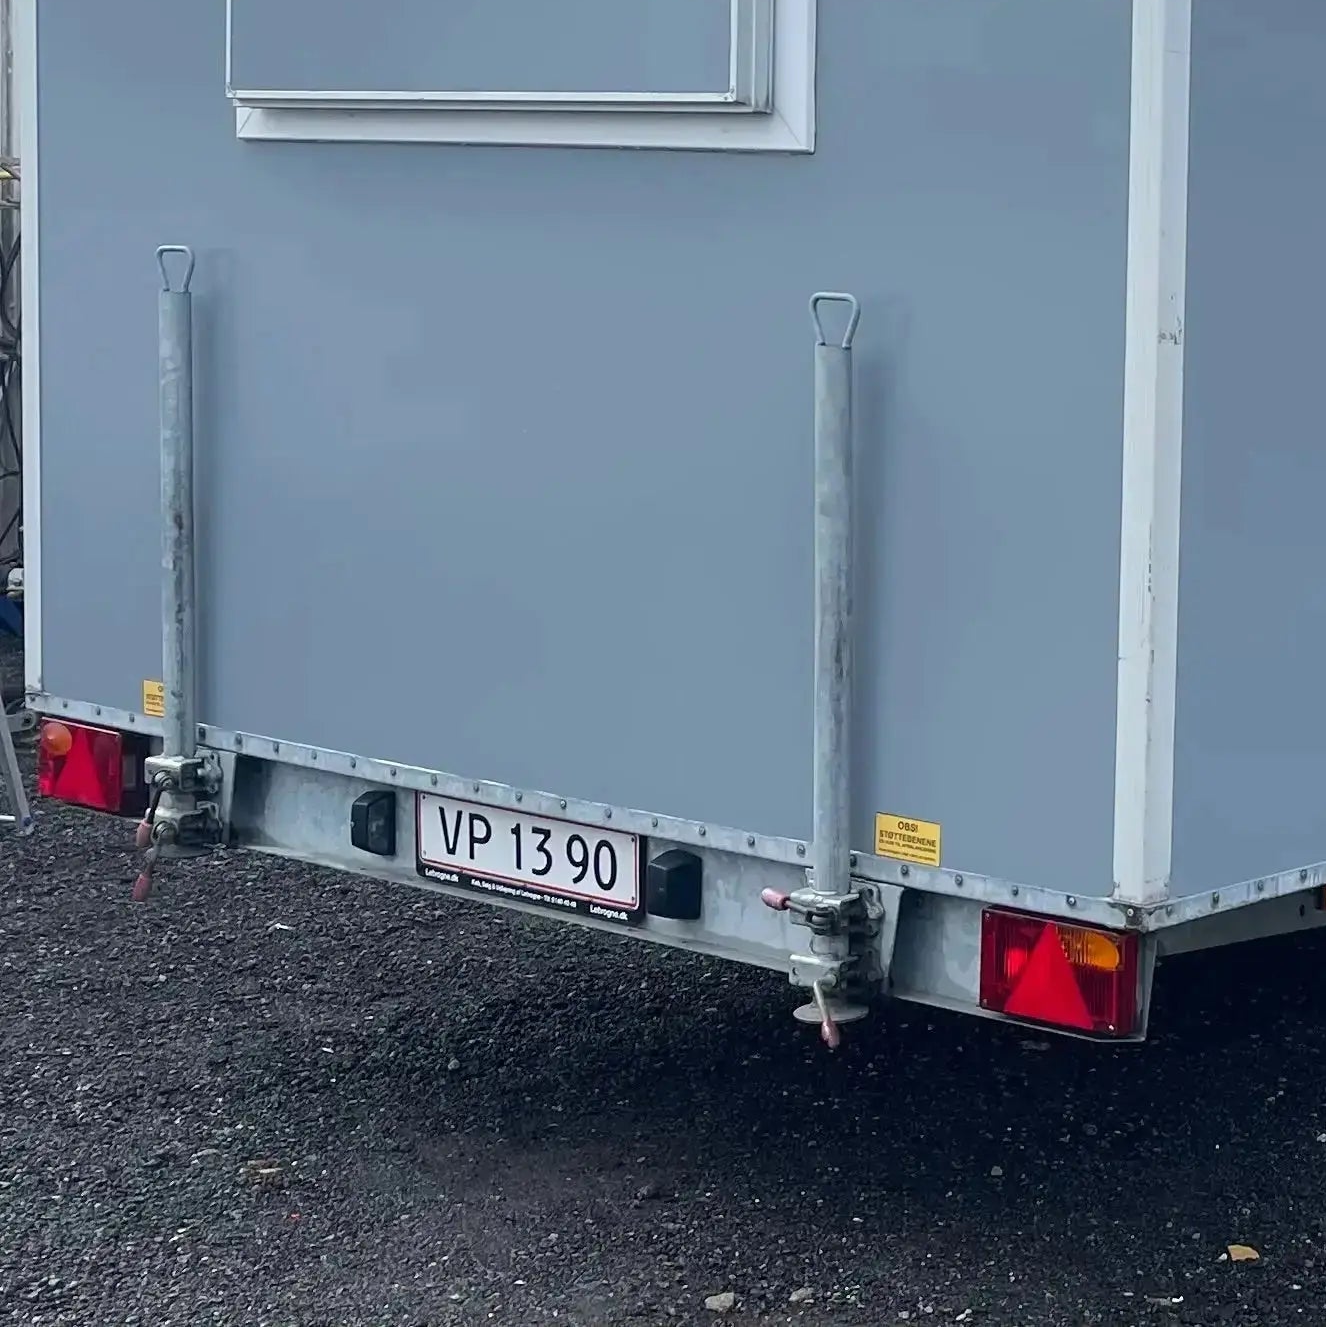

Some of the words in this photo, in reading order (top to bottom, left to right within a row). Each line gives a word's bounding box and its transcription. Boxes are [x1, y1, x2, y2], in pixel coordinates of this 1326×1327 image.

[438, 806, 492, 860] VP
[510, 823, 553, 876] 13
[566, 833, 617, 891] 90
